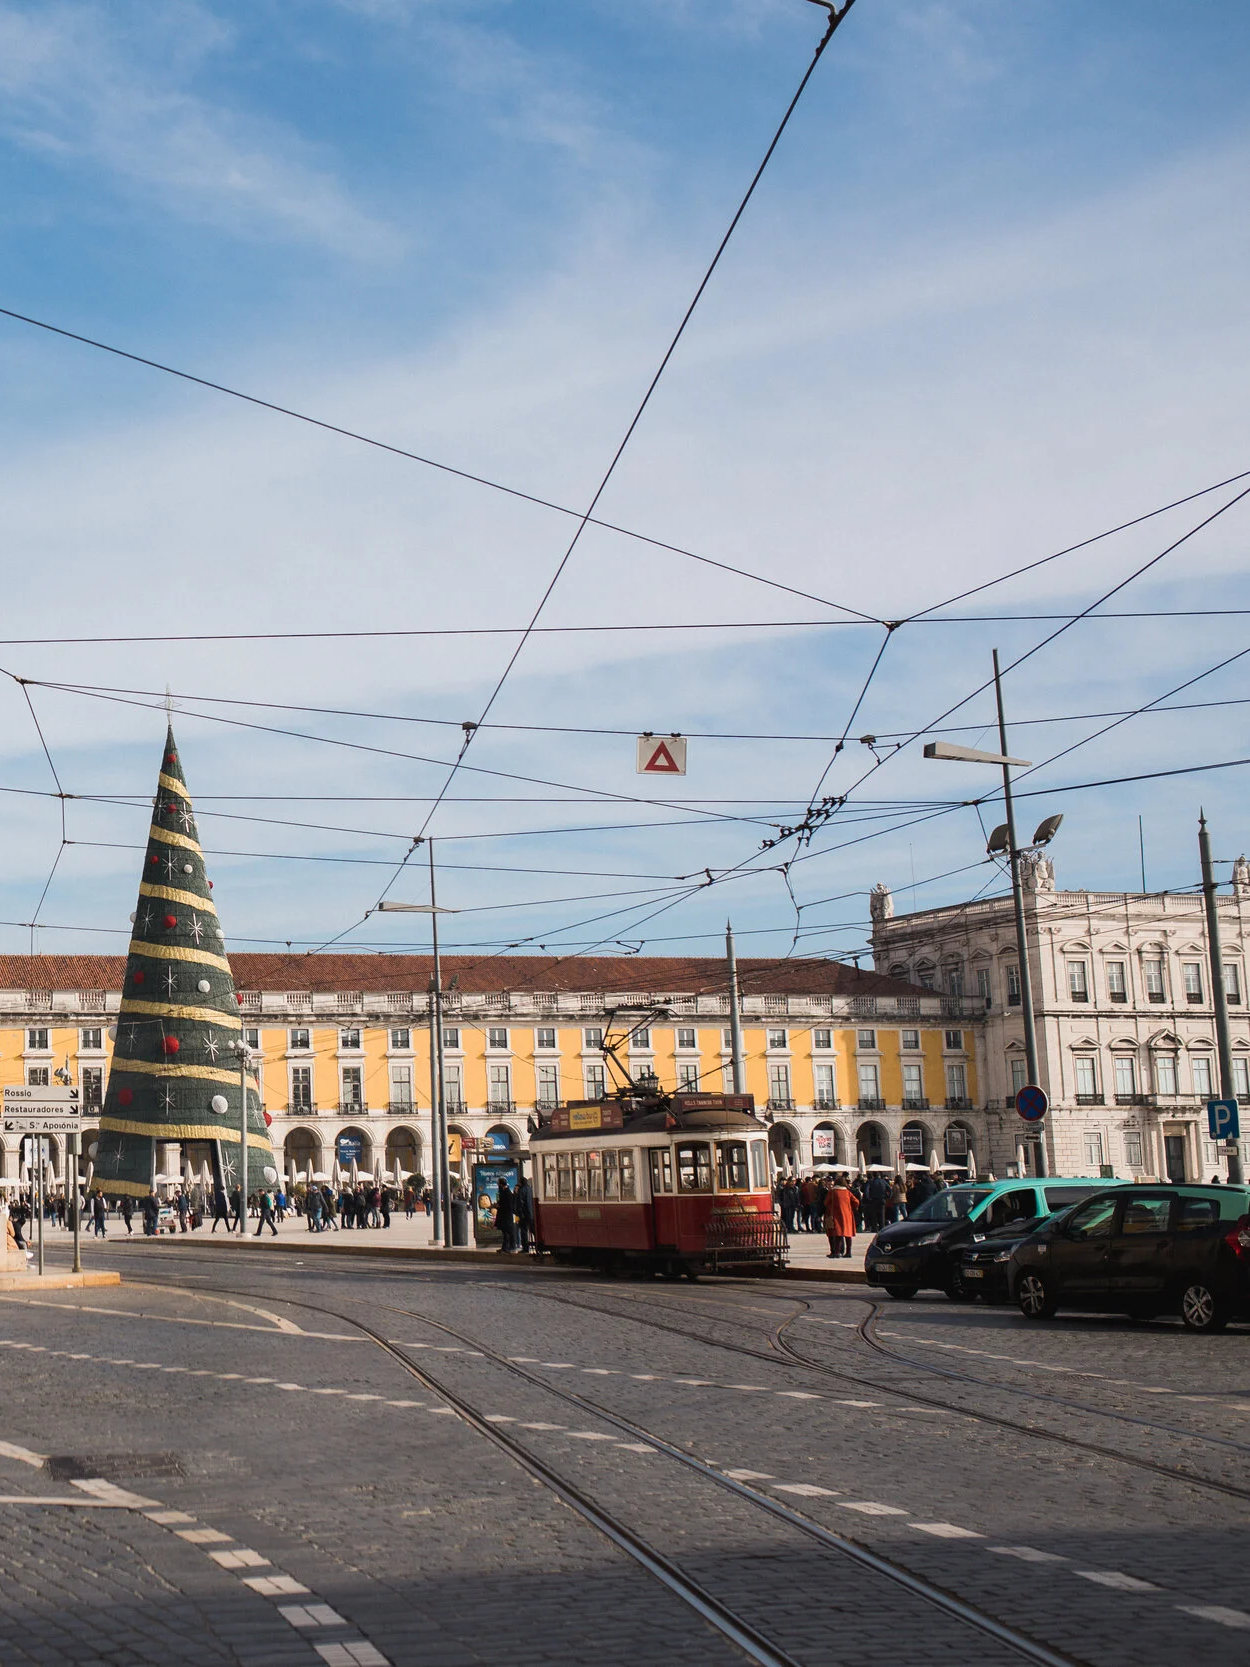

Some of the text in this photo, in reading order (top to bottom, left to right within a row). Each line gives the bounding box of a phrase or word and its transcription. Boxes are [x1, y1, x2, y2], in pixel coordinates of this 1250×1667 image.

[4, 1089, 32, 1097] Rossio
[4, 1105, 64, 1113] Restauradores
[1214, 1105, 1231, 1135] P
